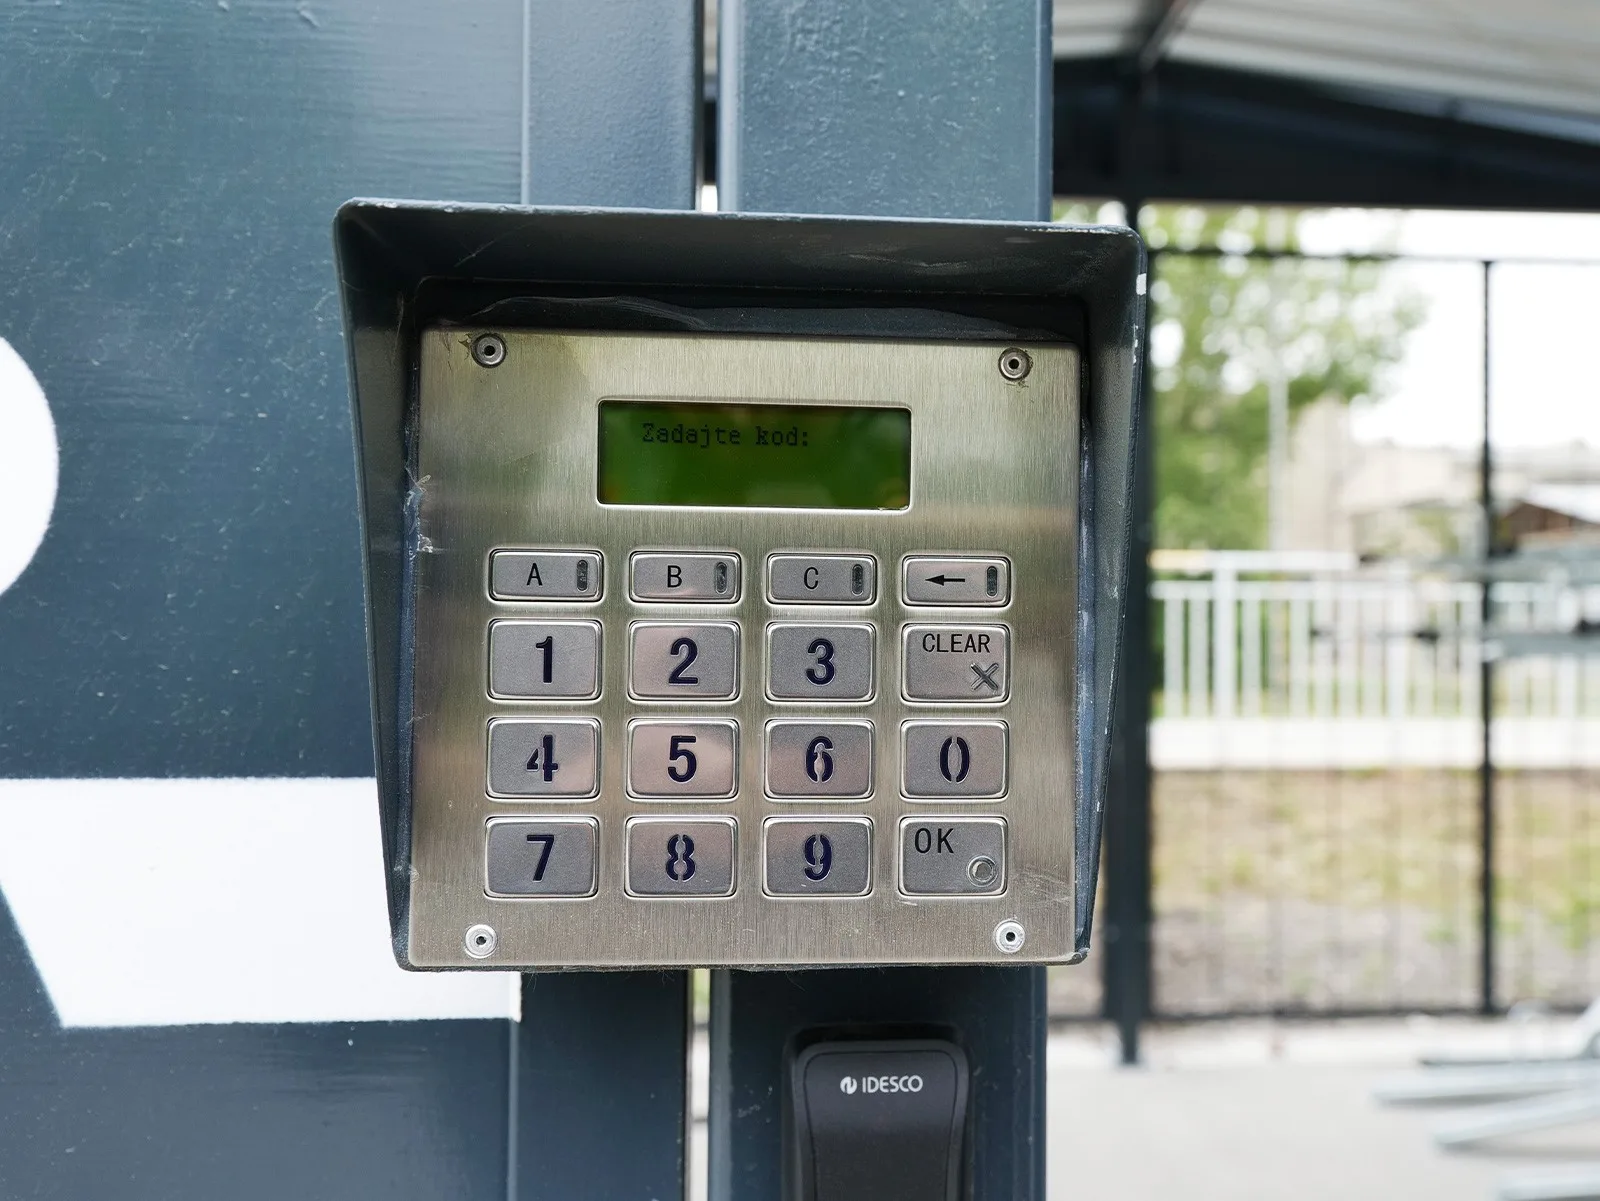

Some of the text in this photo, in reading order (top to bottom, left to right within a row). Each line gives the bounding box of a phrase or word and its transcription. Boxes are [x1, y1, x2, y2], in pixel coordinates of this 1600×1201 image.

[642, 423, 741, 449] Zadajte
[527, 563, 543, 586] A
[667, 565, 682, 588] B
[803, 567, 819, 590] C
[535, 635, 553, 683] 1
[669, 638, 699, 685] 2
[806, 639, 835, 685] 3
[922, 633, 990, 654] CLEAR
[526, 734, 558, 782] 4
[667, 735, 697, 783] 5
[805, 736, 834, 783] 6
[939, 736, 970, 783] 0
[526, 834, 555, 882] 7
[666, 834, 696, 881] 8
[804, 834, 832, 881] 9
[914, 828, 954, 854] OK
[862, 1075, 924, 1094] IDESCO
